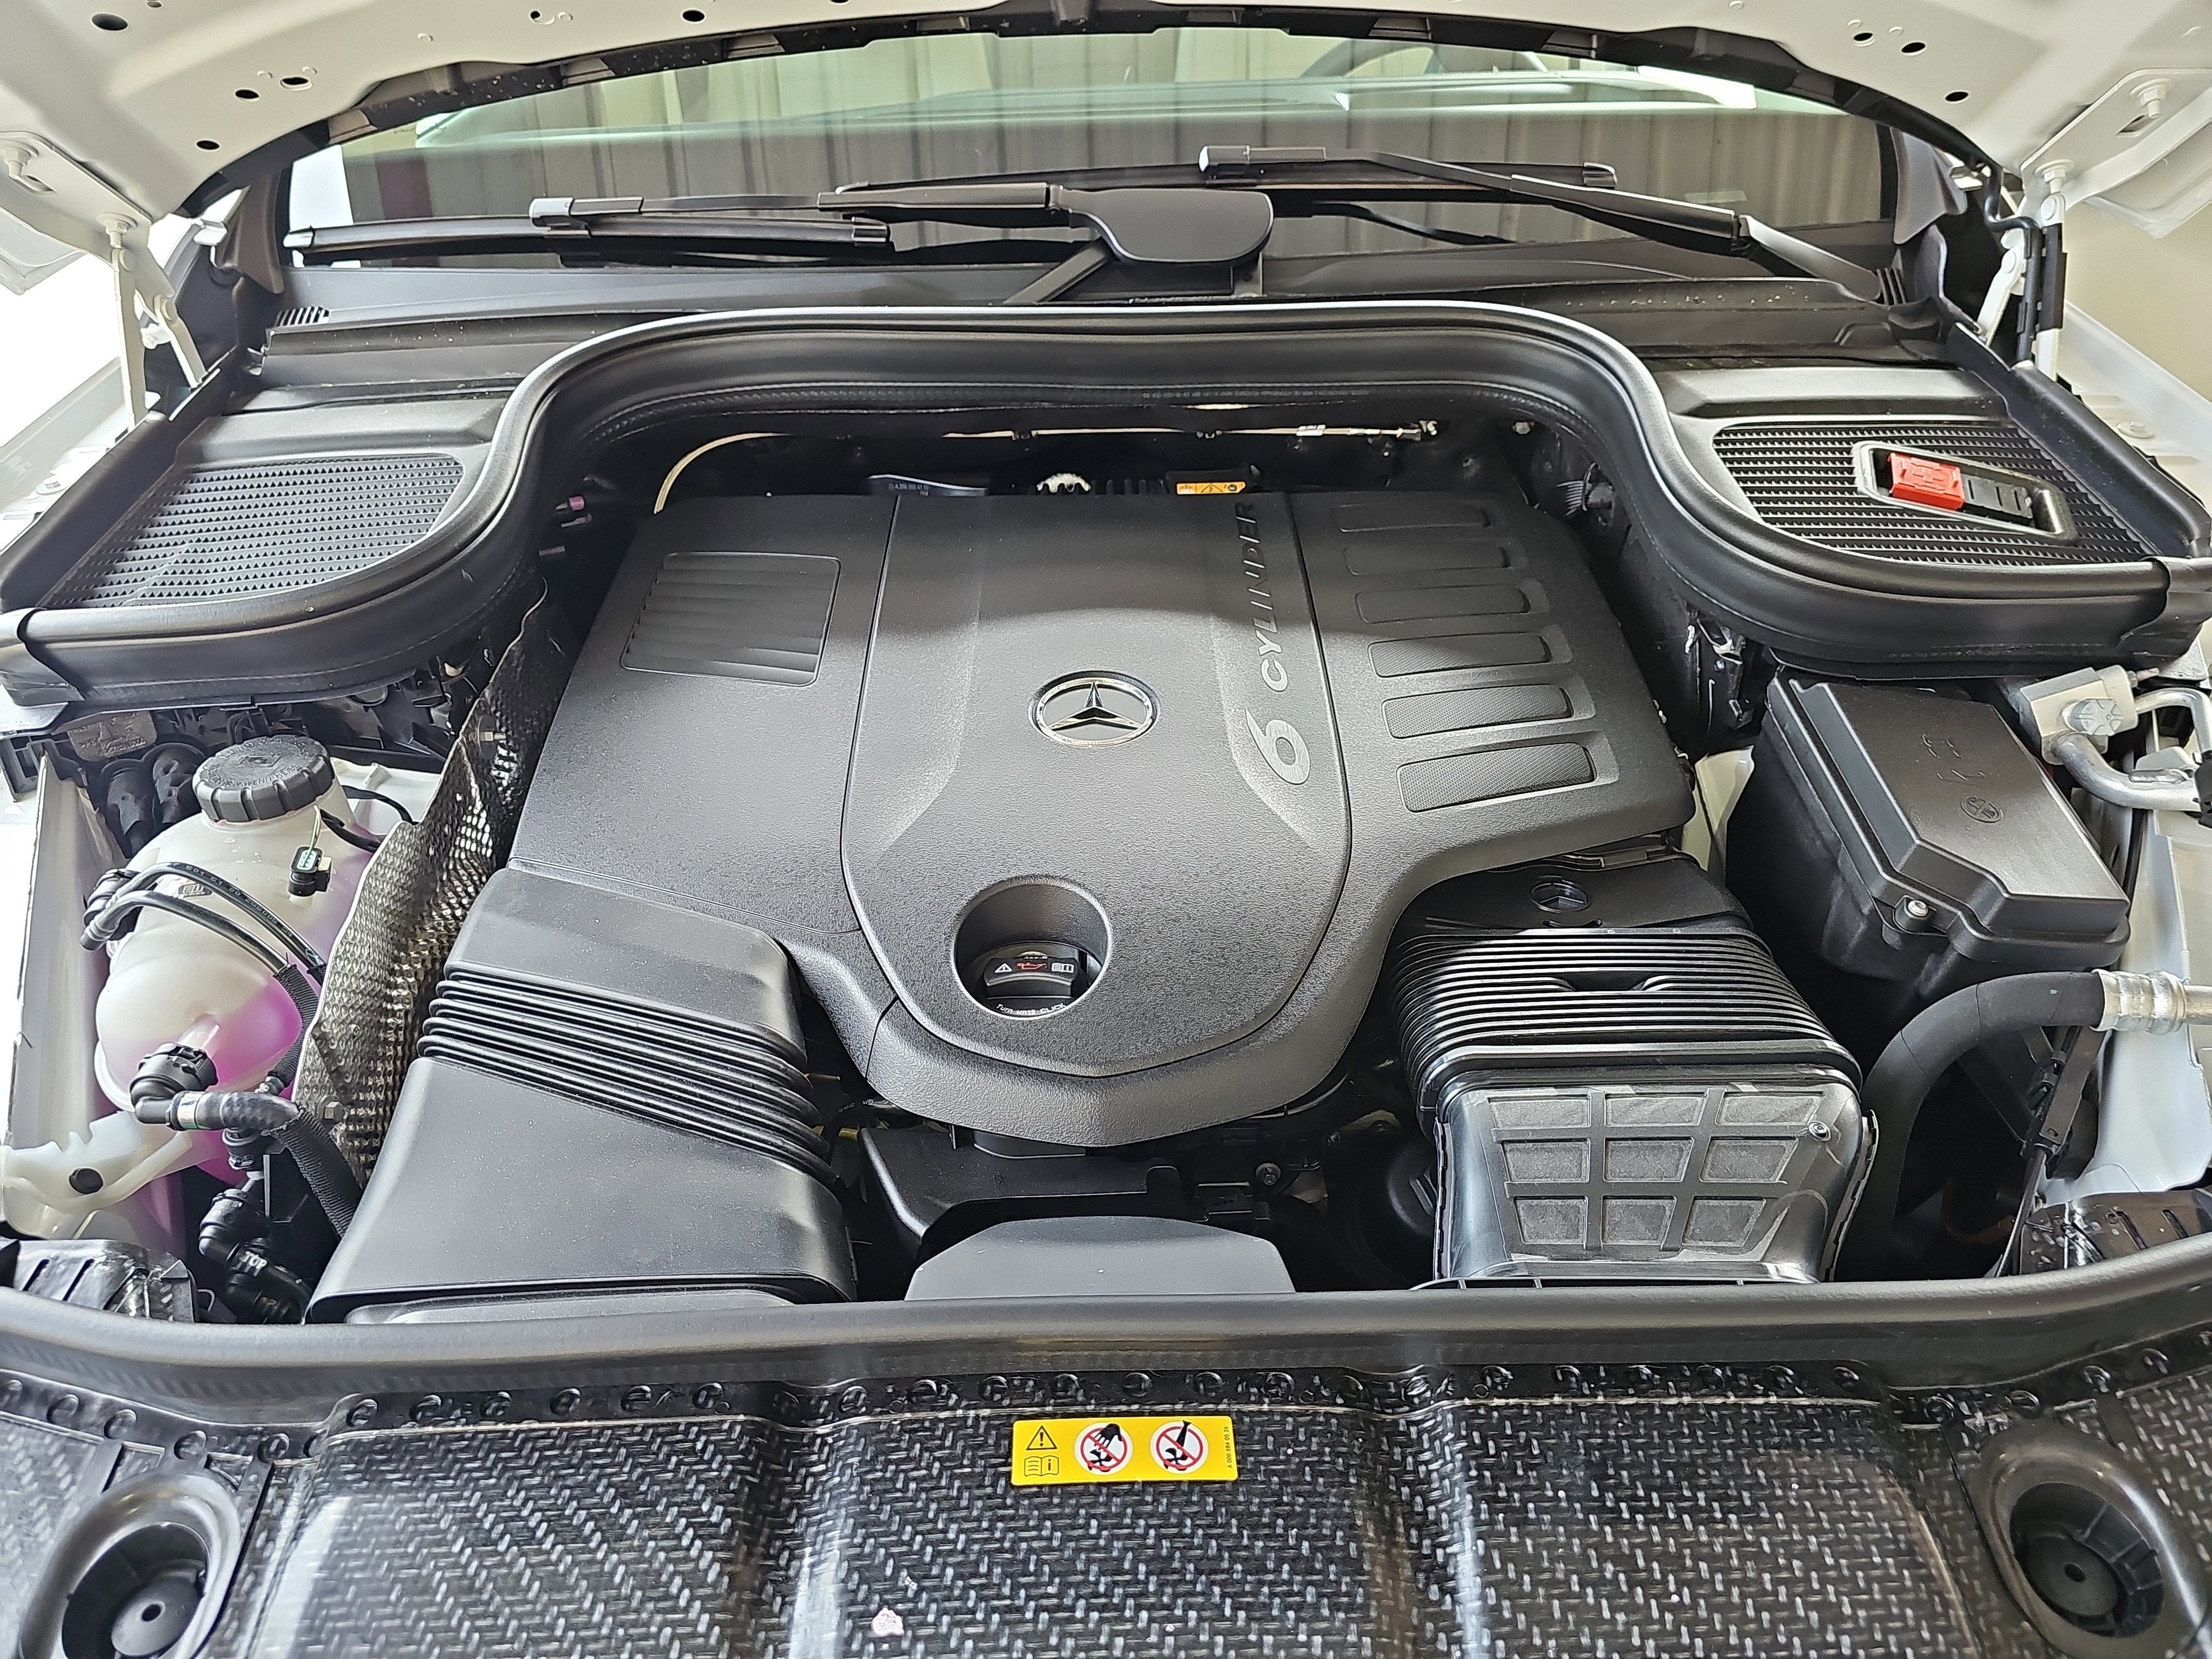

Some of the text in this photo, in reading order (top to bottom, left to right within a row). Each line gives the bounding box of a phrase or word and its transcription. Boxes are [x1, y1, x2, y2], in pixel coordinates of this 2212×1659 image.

[1234, 501, 1311, 785] 6 CYLINDER
[996, 1004, 1013, 1013] Turn
[1040, 1002, 1066, 1014] CLICK
